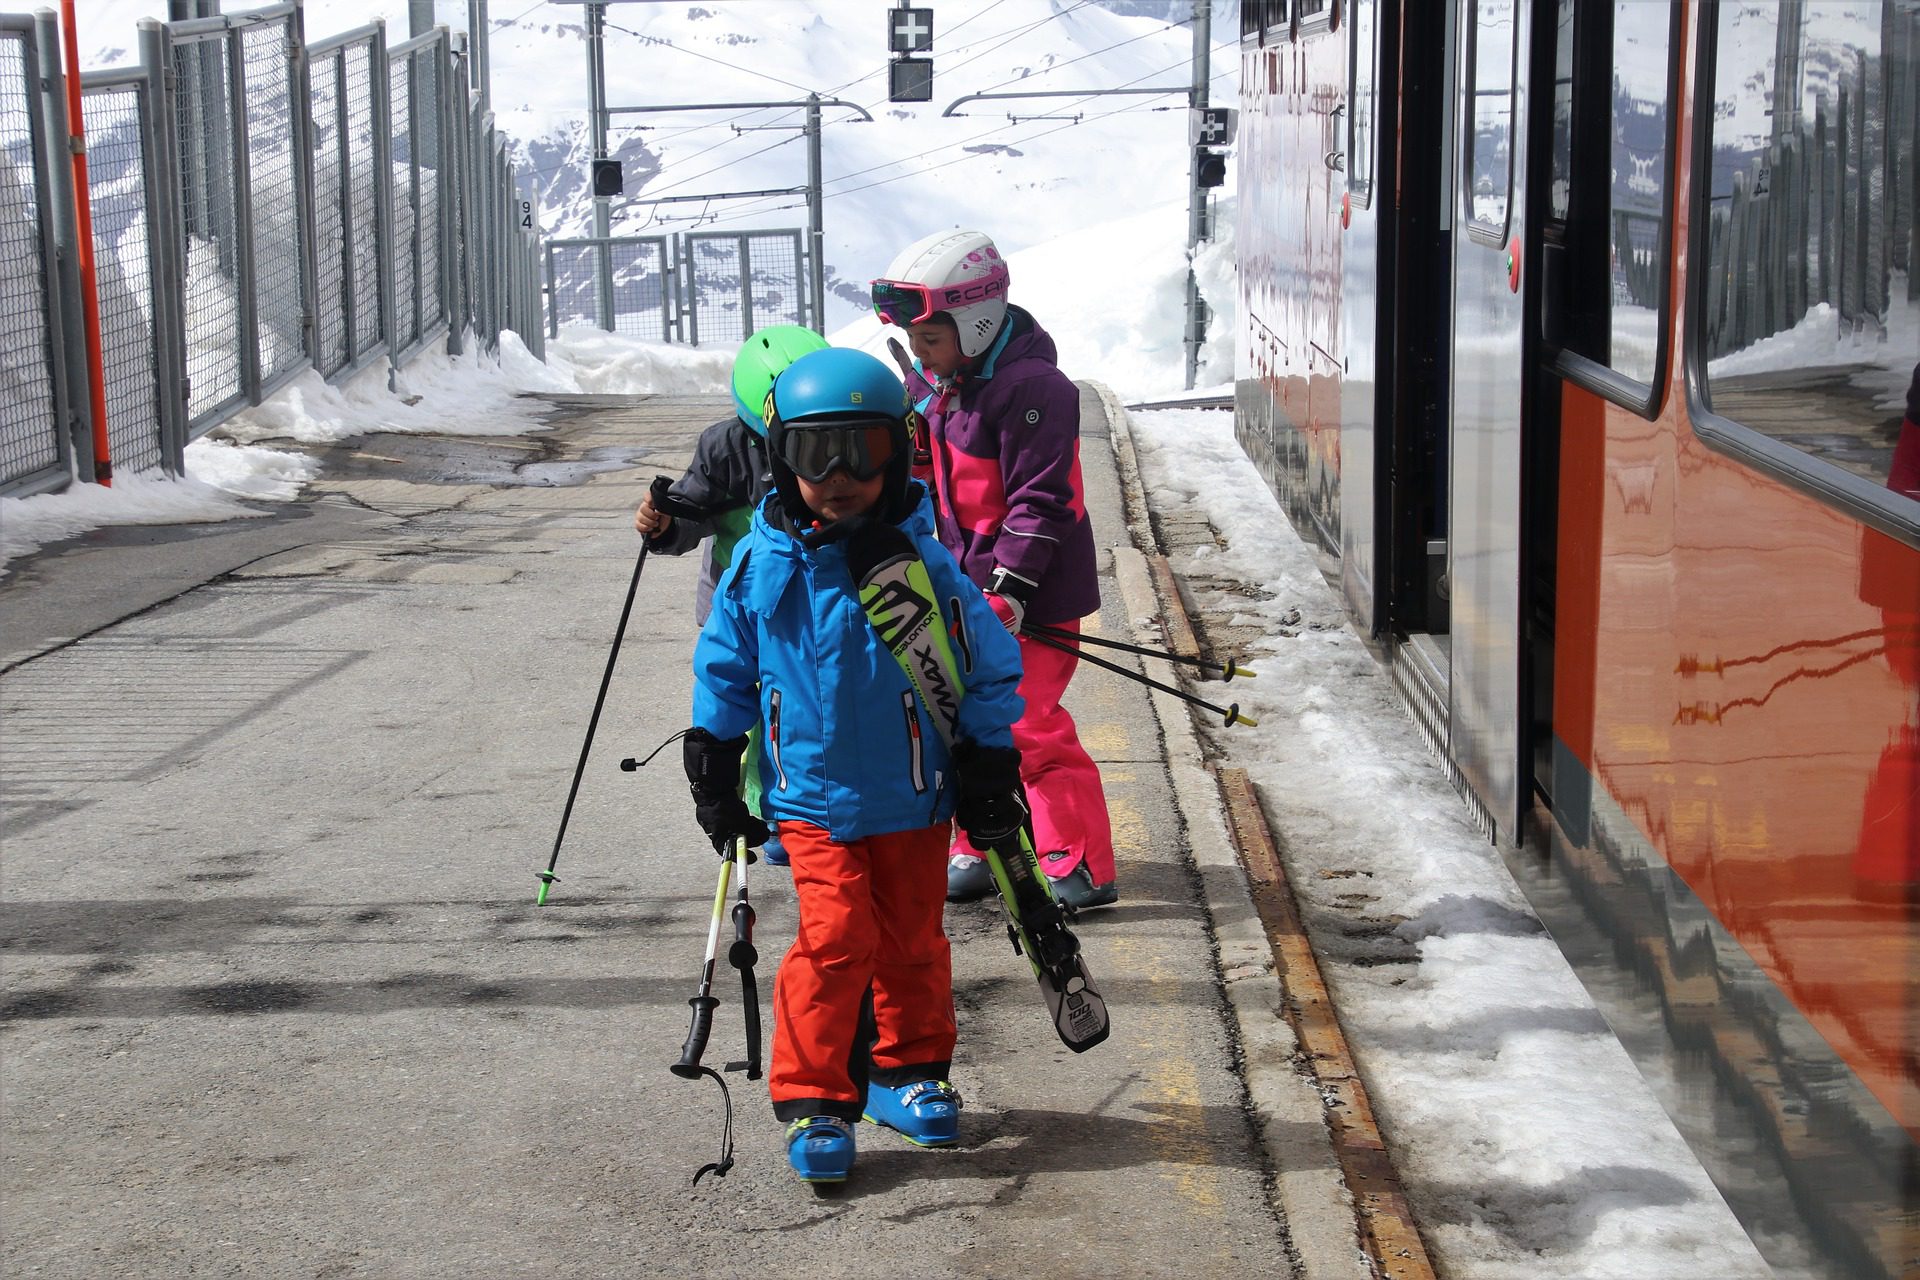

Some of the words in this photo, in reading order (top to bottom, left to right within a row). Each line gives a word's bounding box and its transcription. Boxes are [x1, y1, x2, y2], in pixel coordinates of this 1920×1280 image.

[522, 201, 531, 213] 9
[521, 214, 533, 229] 4
[1068, 1003, 1090, 1020] 100
